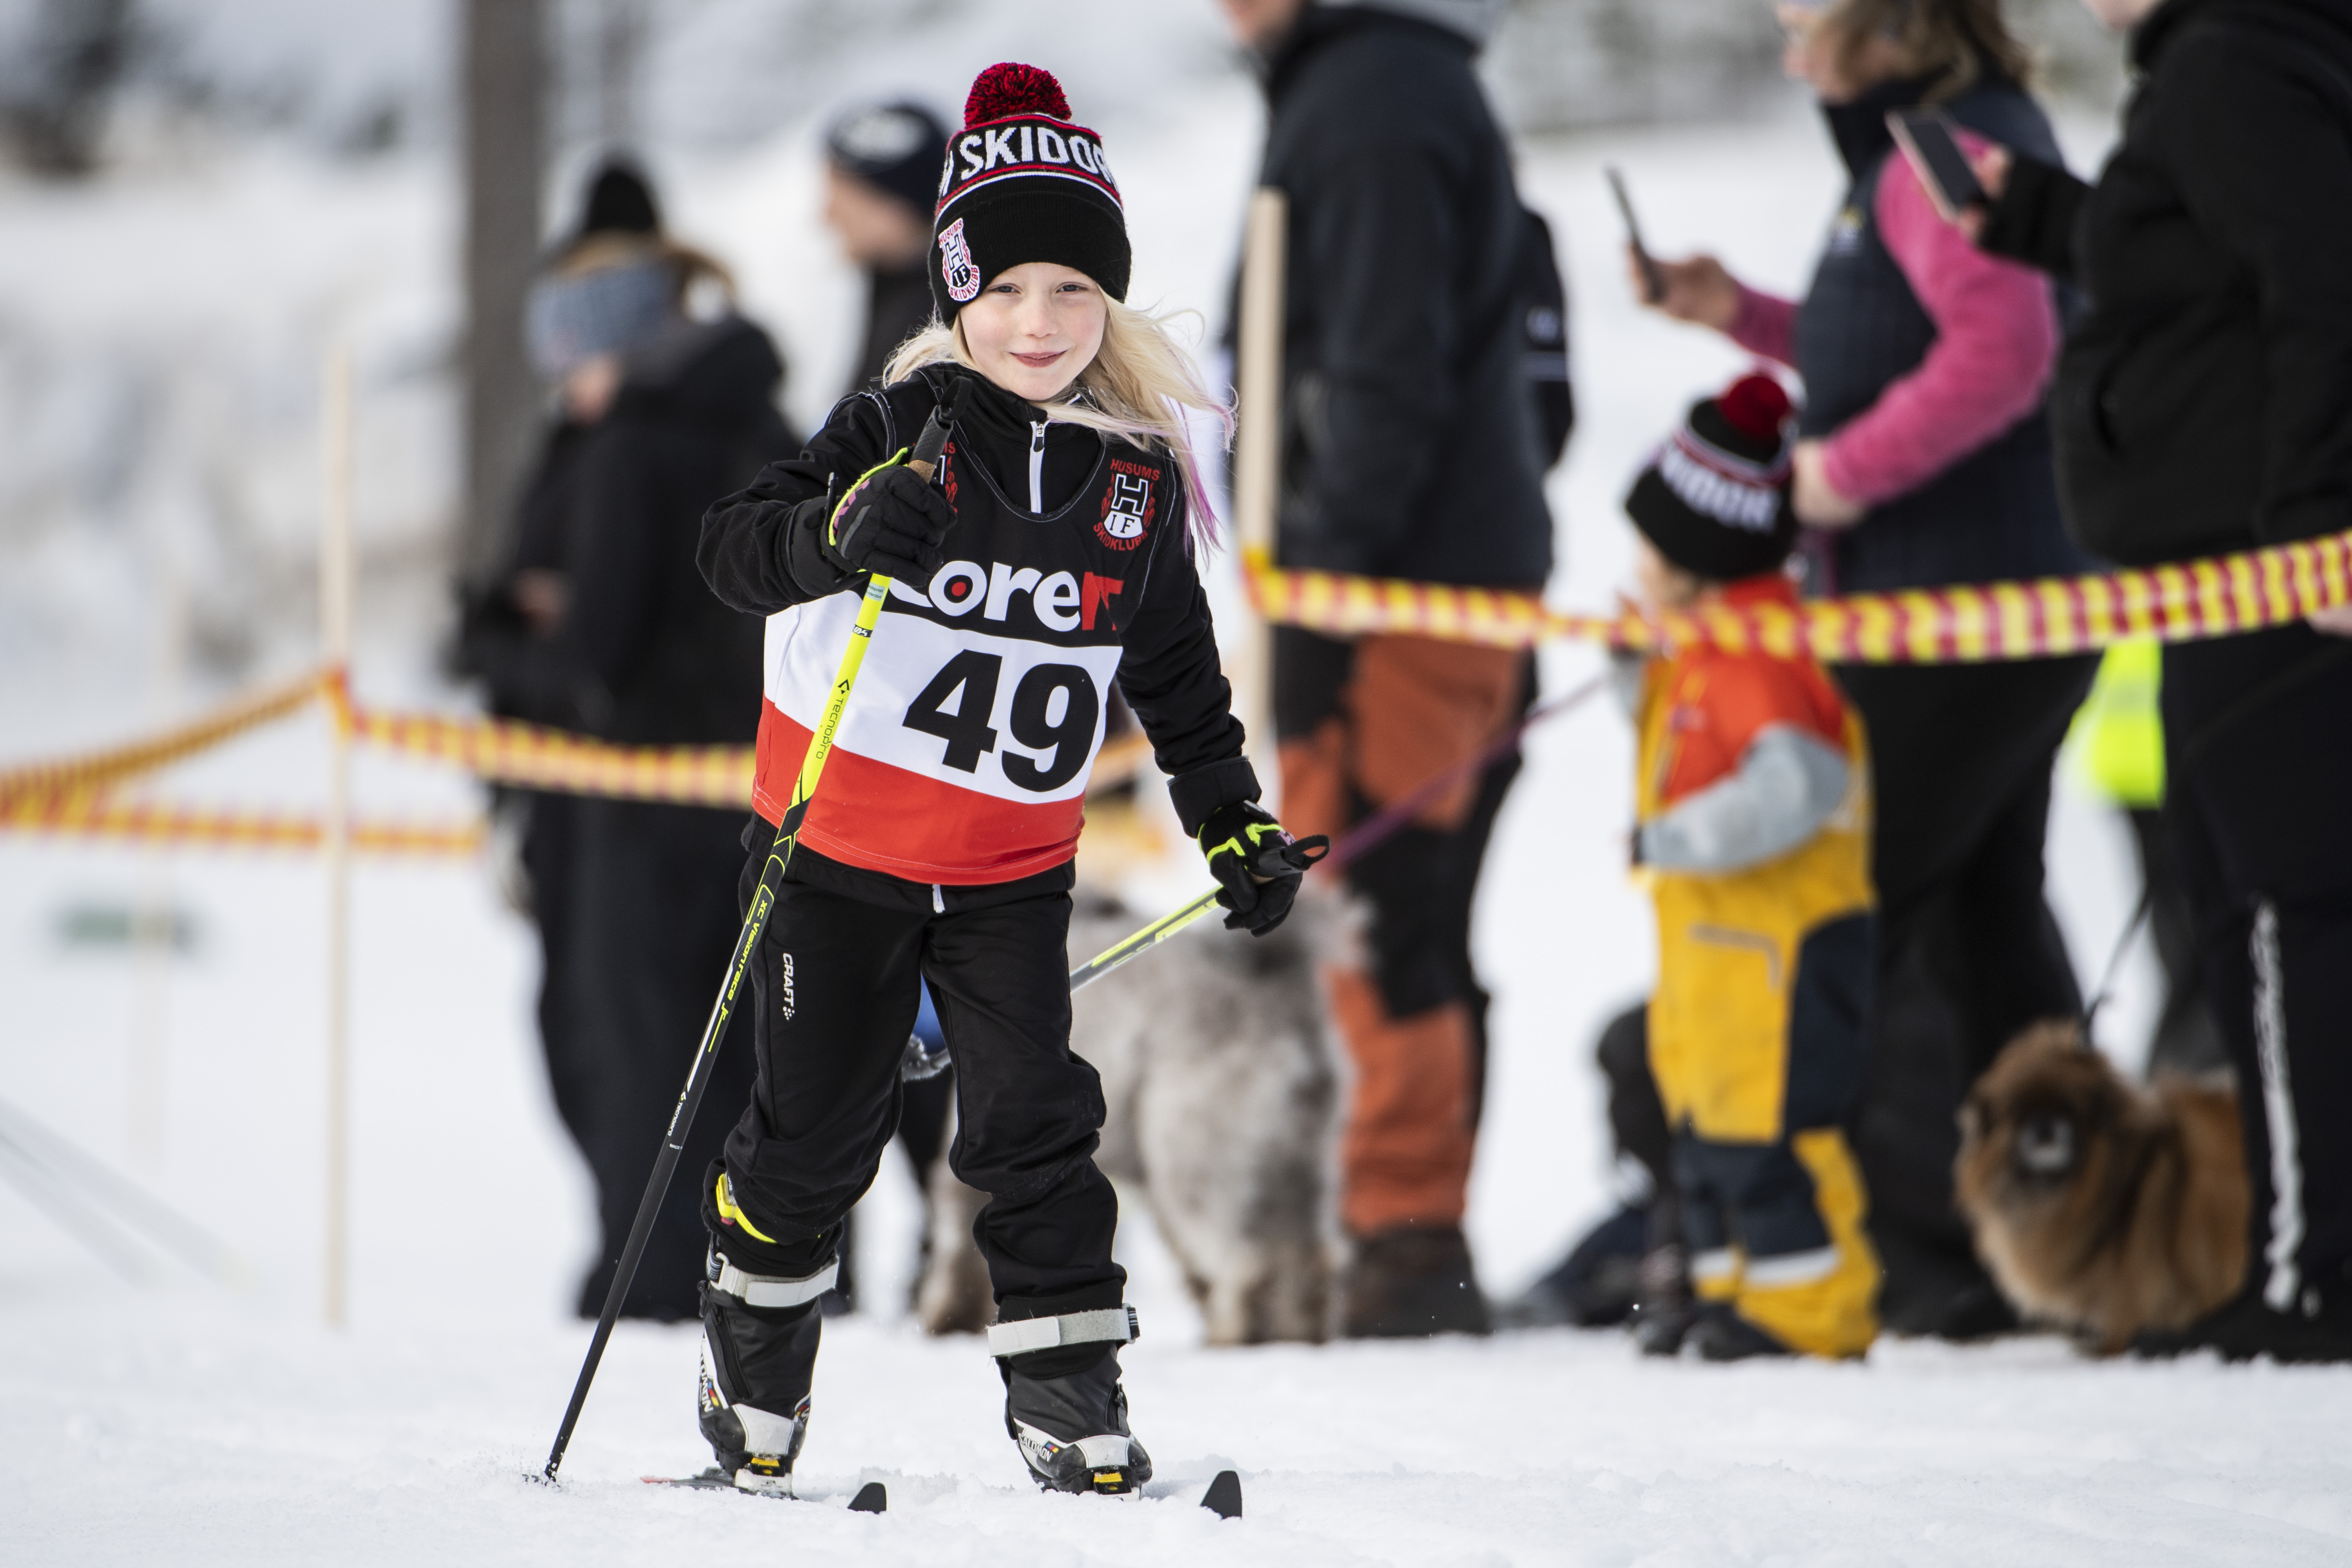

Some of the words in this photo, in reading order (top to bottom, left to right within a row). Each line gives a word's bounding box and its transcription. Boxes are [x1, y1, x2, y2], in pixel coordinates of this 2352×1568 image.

[939, 220, 962, 245] HUSUMS
[950, 267, 978, 299] SKIDKLUBB
[1110, 458, 1160, 481] HUSUMS
[1093, 522, 1148, 550] SKIDKLUBB
[902, 649, 1099, 792] 49
[727, 964, 744, 1001] race
[783, 953, 794, 1007] CRAFT
[1018, 1433, 1052, 1462] SALOMON
